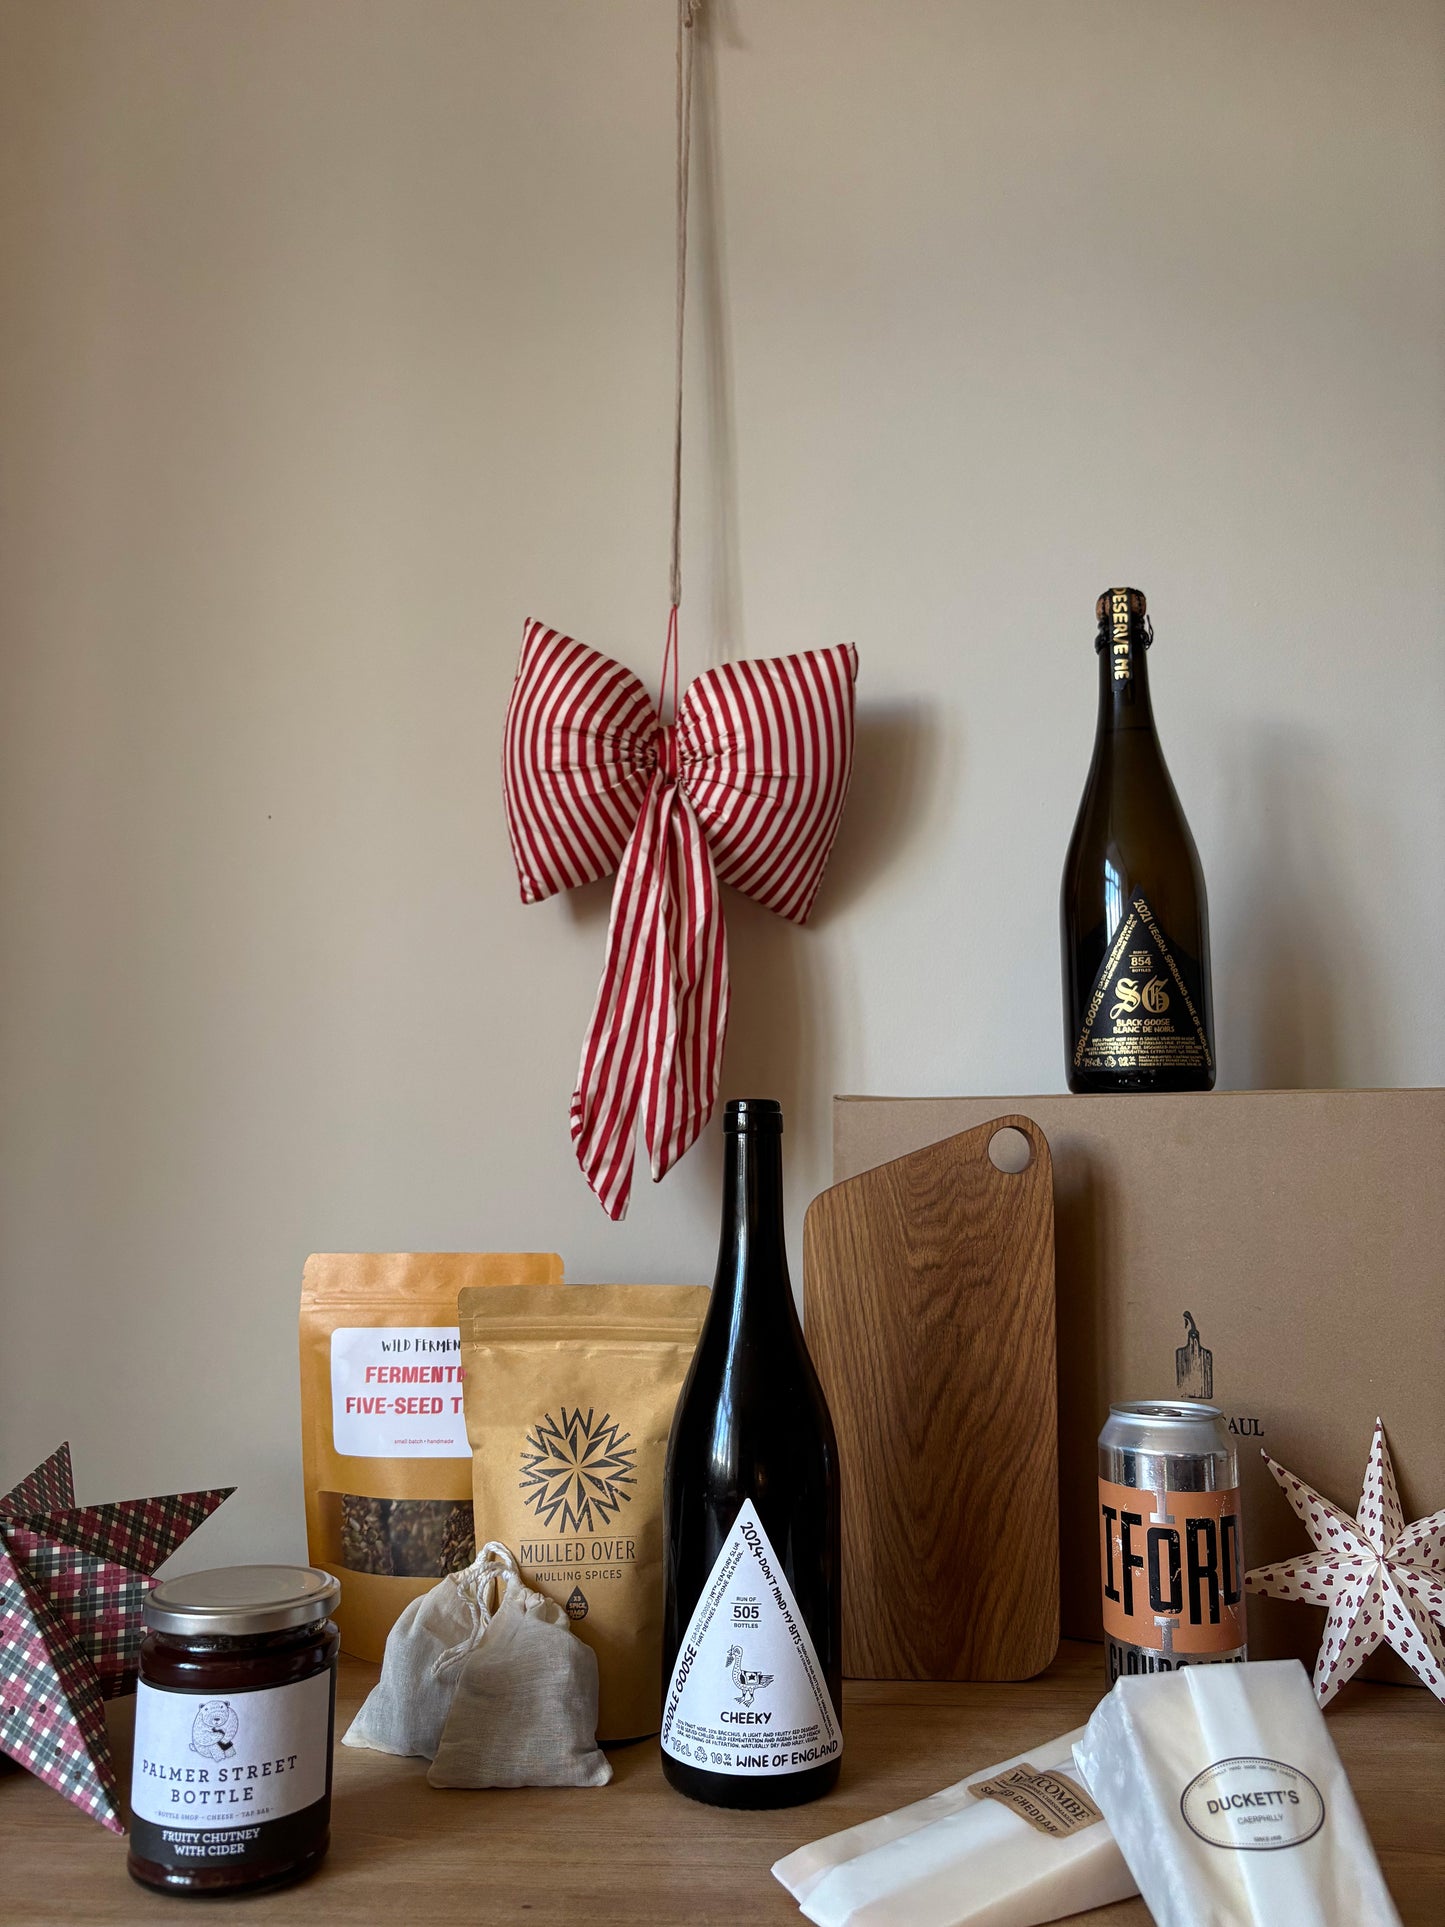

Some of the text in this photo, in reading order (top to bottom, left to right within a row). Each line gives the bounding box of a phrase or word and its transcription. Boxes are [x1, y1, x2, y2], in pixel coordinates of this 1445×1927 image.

[1113, 658, 1130, 680] ME
[1133, 899, 1153, 923] 2021
[1131, 957, 1152, 966] 854
[1074, 990, 1105, 1067] SADDLE GOOSE
[1113, 1026, 1140, 1034] BLANC
[1154, 1025, 1175, 1033] NOIRS
[1116, 1018, 1170, 1027] BLACK GOOSE
[381, 1339, 411, 1353] WILD
[345, 1397, 444, 1415] FIVE-SEED
[1222, 1416, 1265, 1437] AUL
[520, 1540, 636, 1563] MULLED OVER
[717, 1557, 732, 1587] CENTURY
[729, 1542, 740, 1558] SLUR
[1101, 1504, 1242, 1625] IFORD
[535, 1569, 622, 1582] MULLING SPICES
[740, 1521, 802, 1645] 2024 DON'T MIND MY BITS
[695, 1632, 705, 1647] THAT
[702, 1608, 717, 1633] DEFINES
[713, 1579, 730, 1608] SOMEONE
[726, 1570, 734, 1580] AS
[733, 1606, 760, 1619] 505
[663, 1644, 698, 1744] SADDLE GOOSE
[685, 1720, 696, 1730] PINOT
[800, 1724, 819, 1733] DESIGNED
[720, 1711, 773, 1725] CHEEKY
[728, 1736, 764, 1744] FERMENTATION
[806, 1729, 820, 1737] FRENCH
[736, 1754, 769, 1768] WINE
[772, 1753, 788, 1767] OF
[791, 1739, 838, 1765] ENGLAND
[142, 1755, 298, 1783] PALMER STREET
[171, 1786, 254, 1804] BOTTLE
[1206, 1789, 1300, 1815] DUCKETT'S
[158, 1810, 179, 1820] BOTTLE
[241, 1810, 255, 1818] TAP
[256, 1807, 270, 1815] BAR
[1013, 1795, 1058, 1832] CHEDDAR
[1237, 1814, 1284, 1825] CAERPHILLY
[162, 1828, 261, 1843] FRUITY CHUTNEY
[174, 1842, 245, 1856] WITH CIDER
